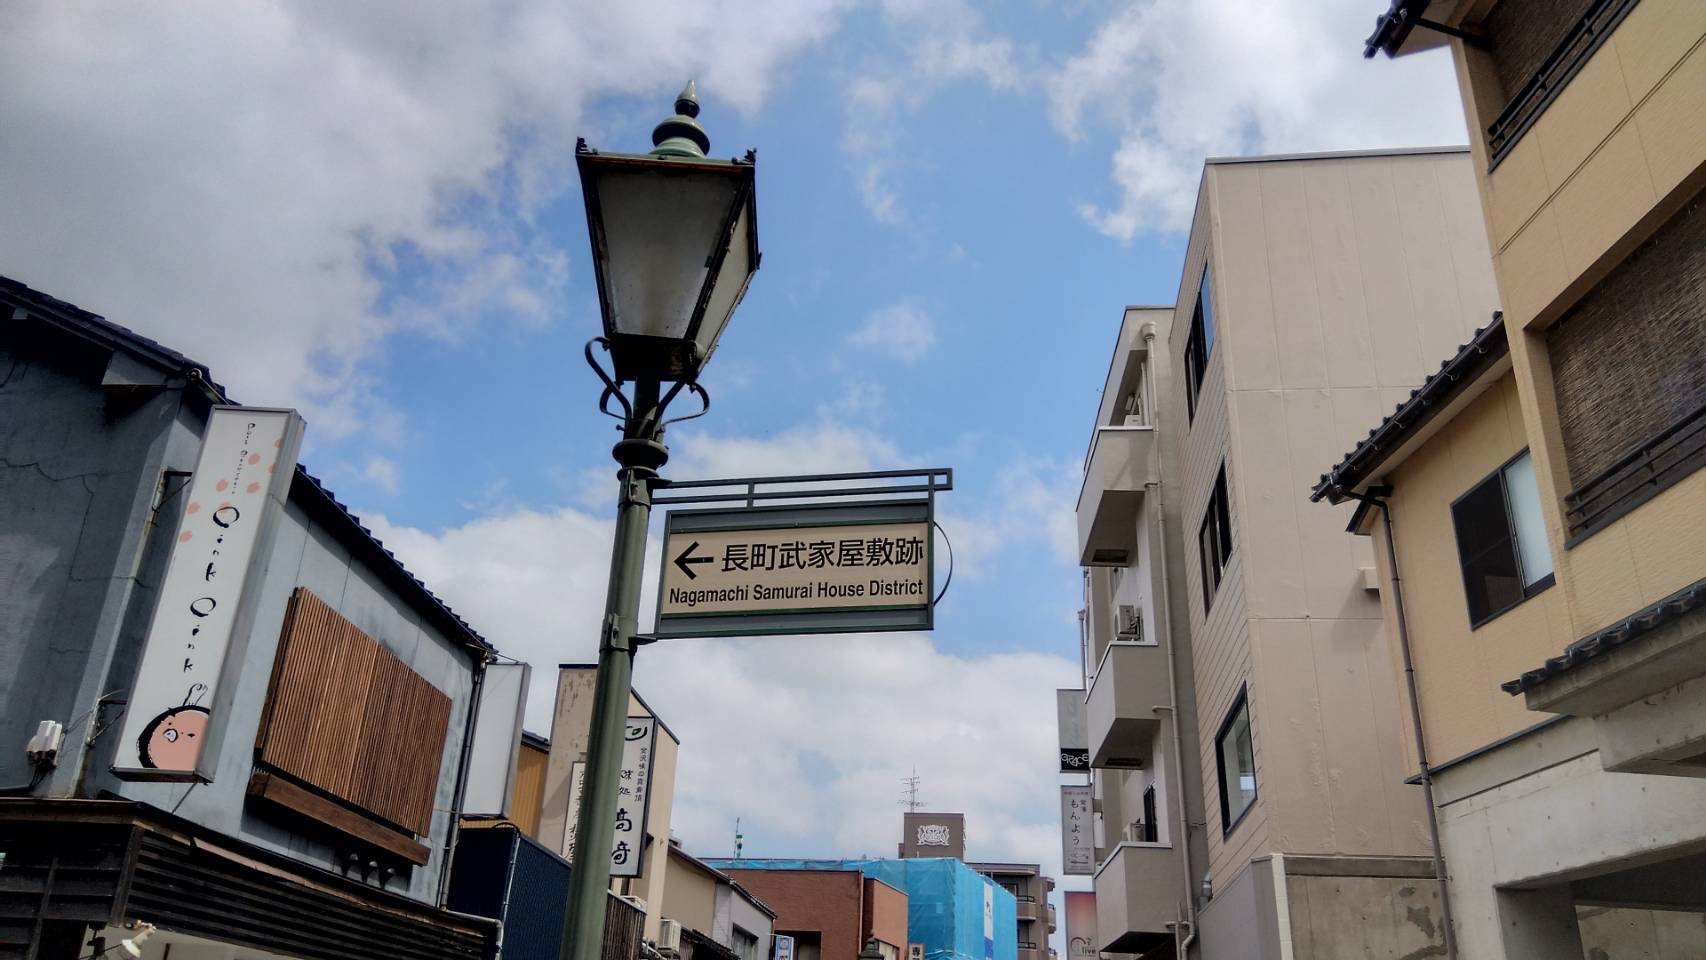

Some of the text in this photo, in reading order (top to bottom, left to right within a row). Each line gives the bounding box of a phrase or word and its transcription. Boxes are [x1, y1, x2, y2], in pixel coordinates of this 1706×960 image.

[204, 506, 240, 581] Oink
[721, 536, 924, 572] 長町武家屋敷跡
[669, 579, 923, 607] Nagamachi Samurai House District
[183, 597, 217, 673] Oink
[1061, 753, 1089, 767] GRACE
[1071, 799, 1080, 846] もんよう
